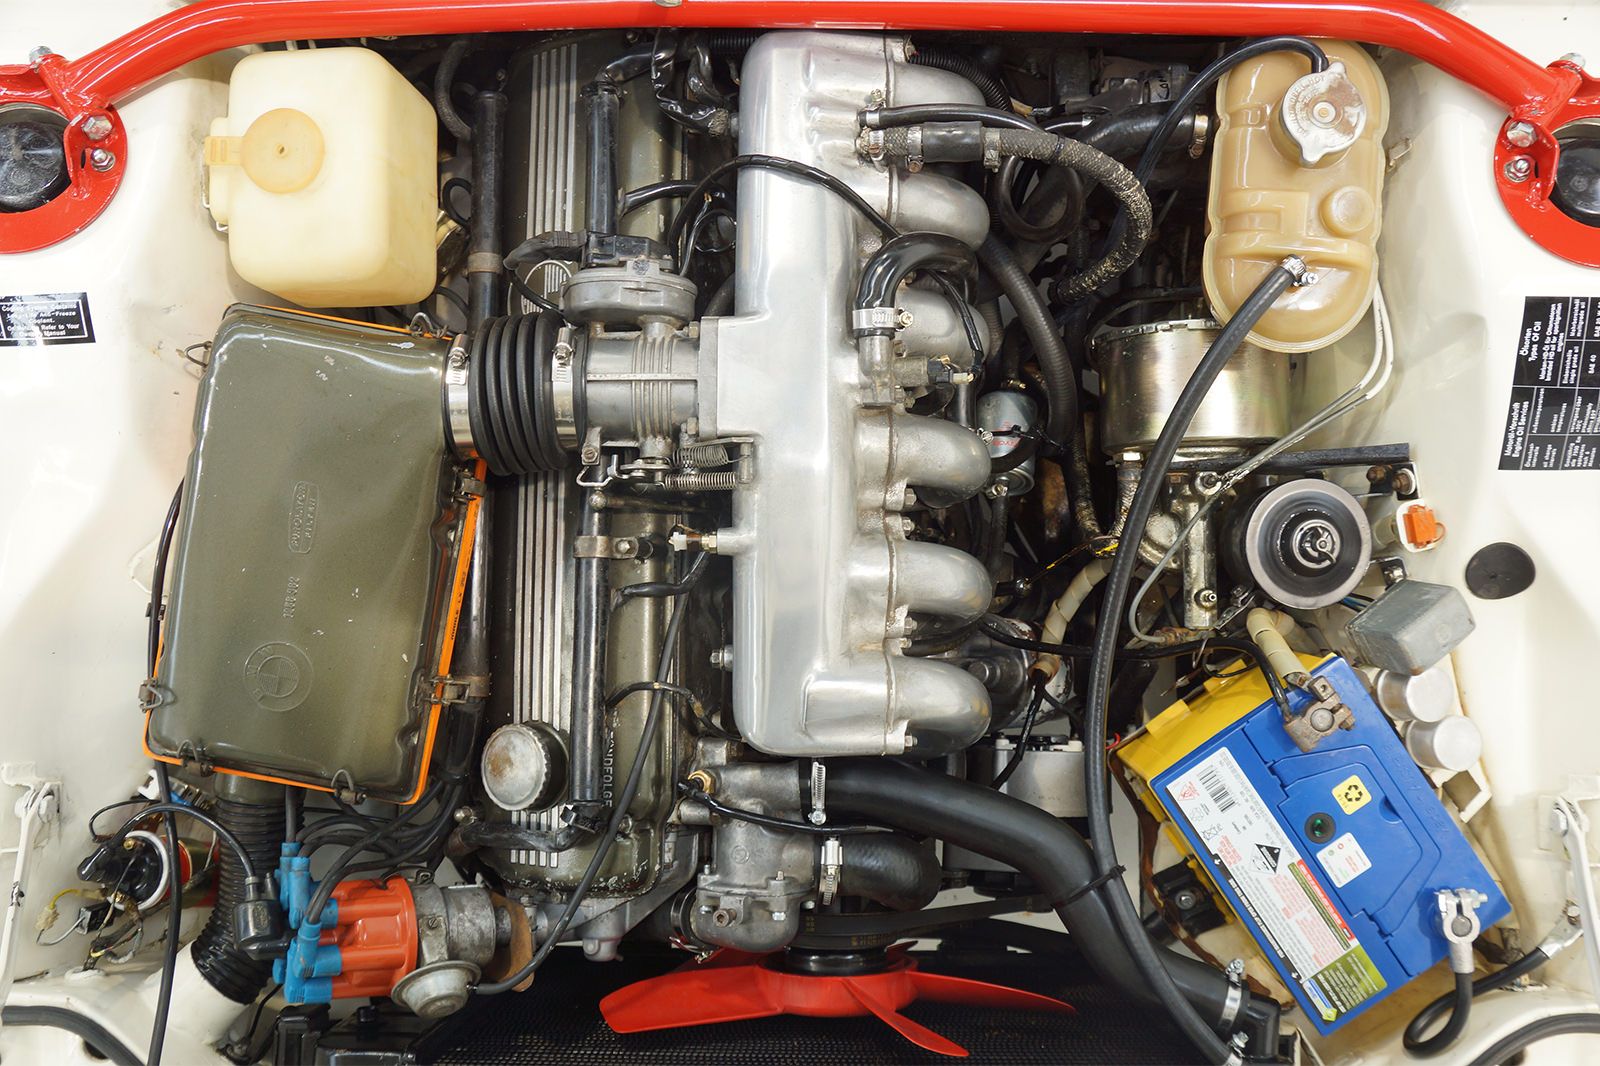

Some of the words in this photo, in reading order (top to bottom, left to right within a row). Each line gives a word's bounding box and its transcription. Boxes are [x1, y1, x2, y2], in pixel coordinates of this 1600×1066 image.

[1519, 328, 1532, 356] Ölsorten
[1532, 332, 1539, 341] Of
[1528, 344, 1538, 362] Types
[1518, 402, 1529, 426] Services
[1516, 426, 1525, 436] Oil
[1512, 437, 1523, 457] Engine
